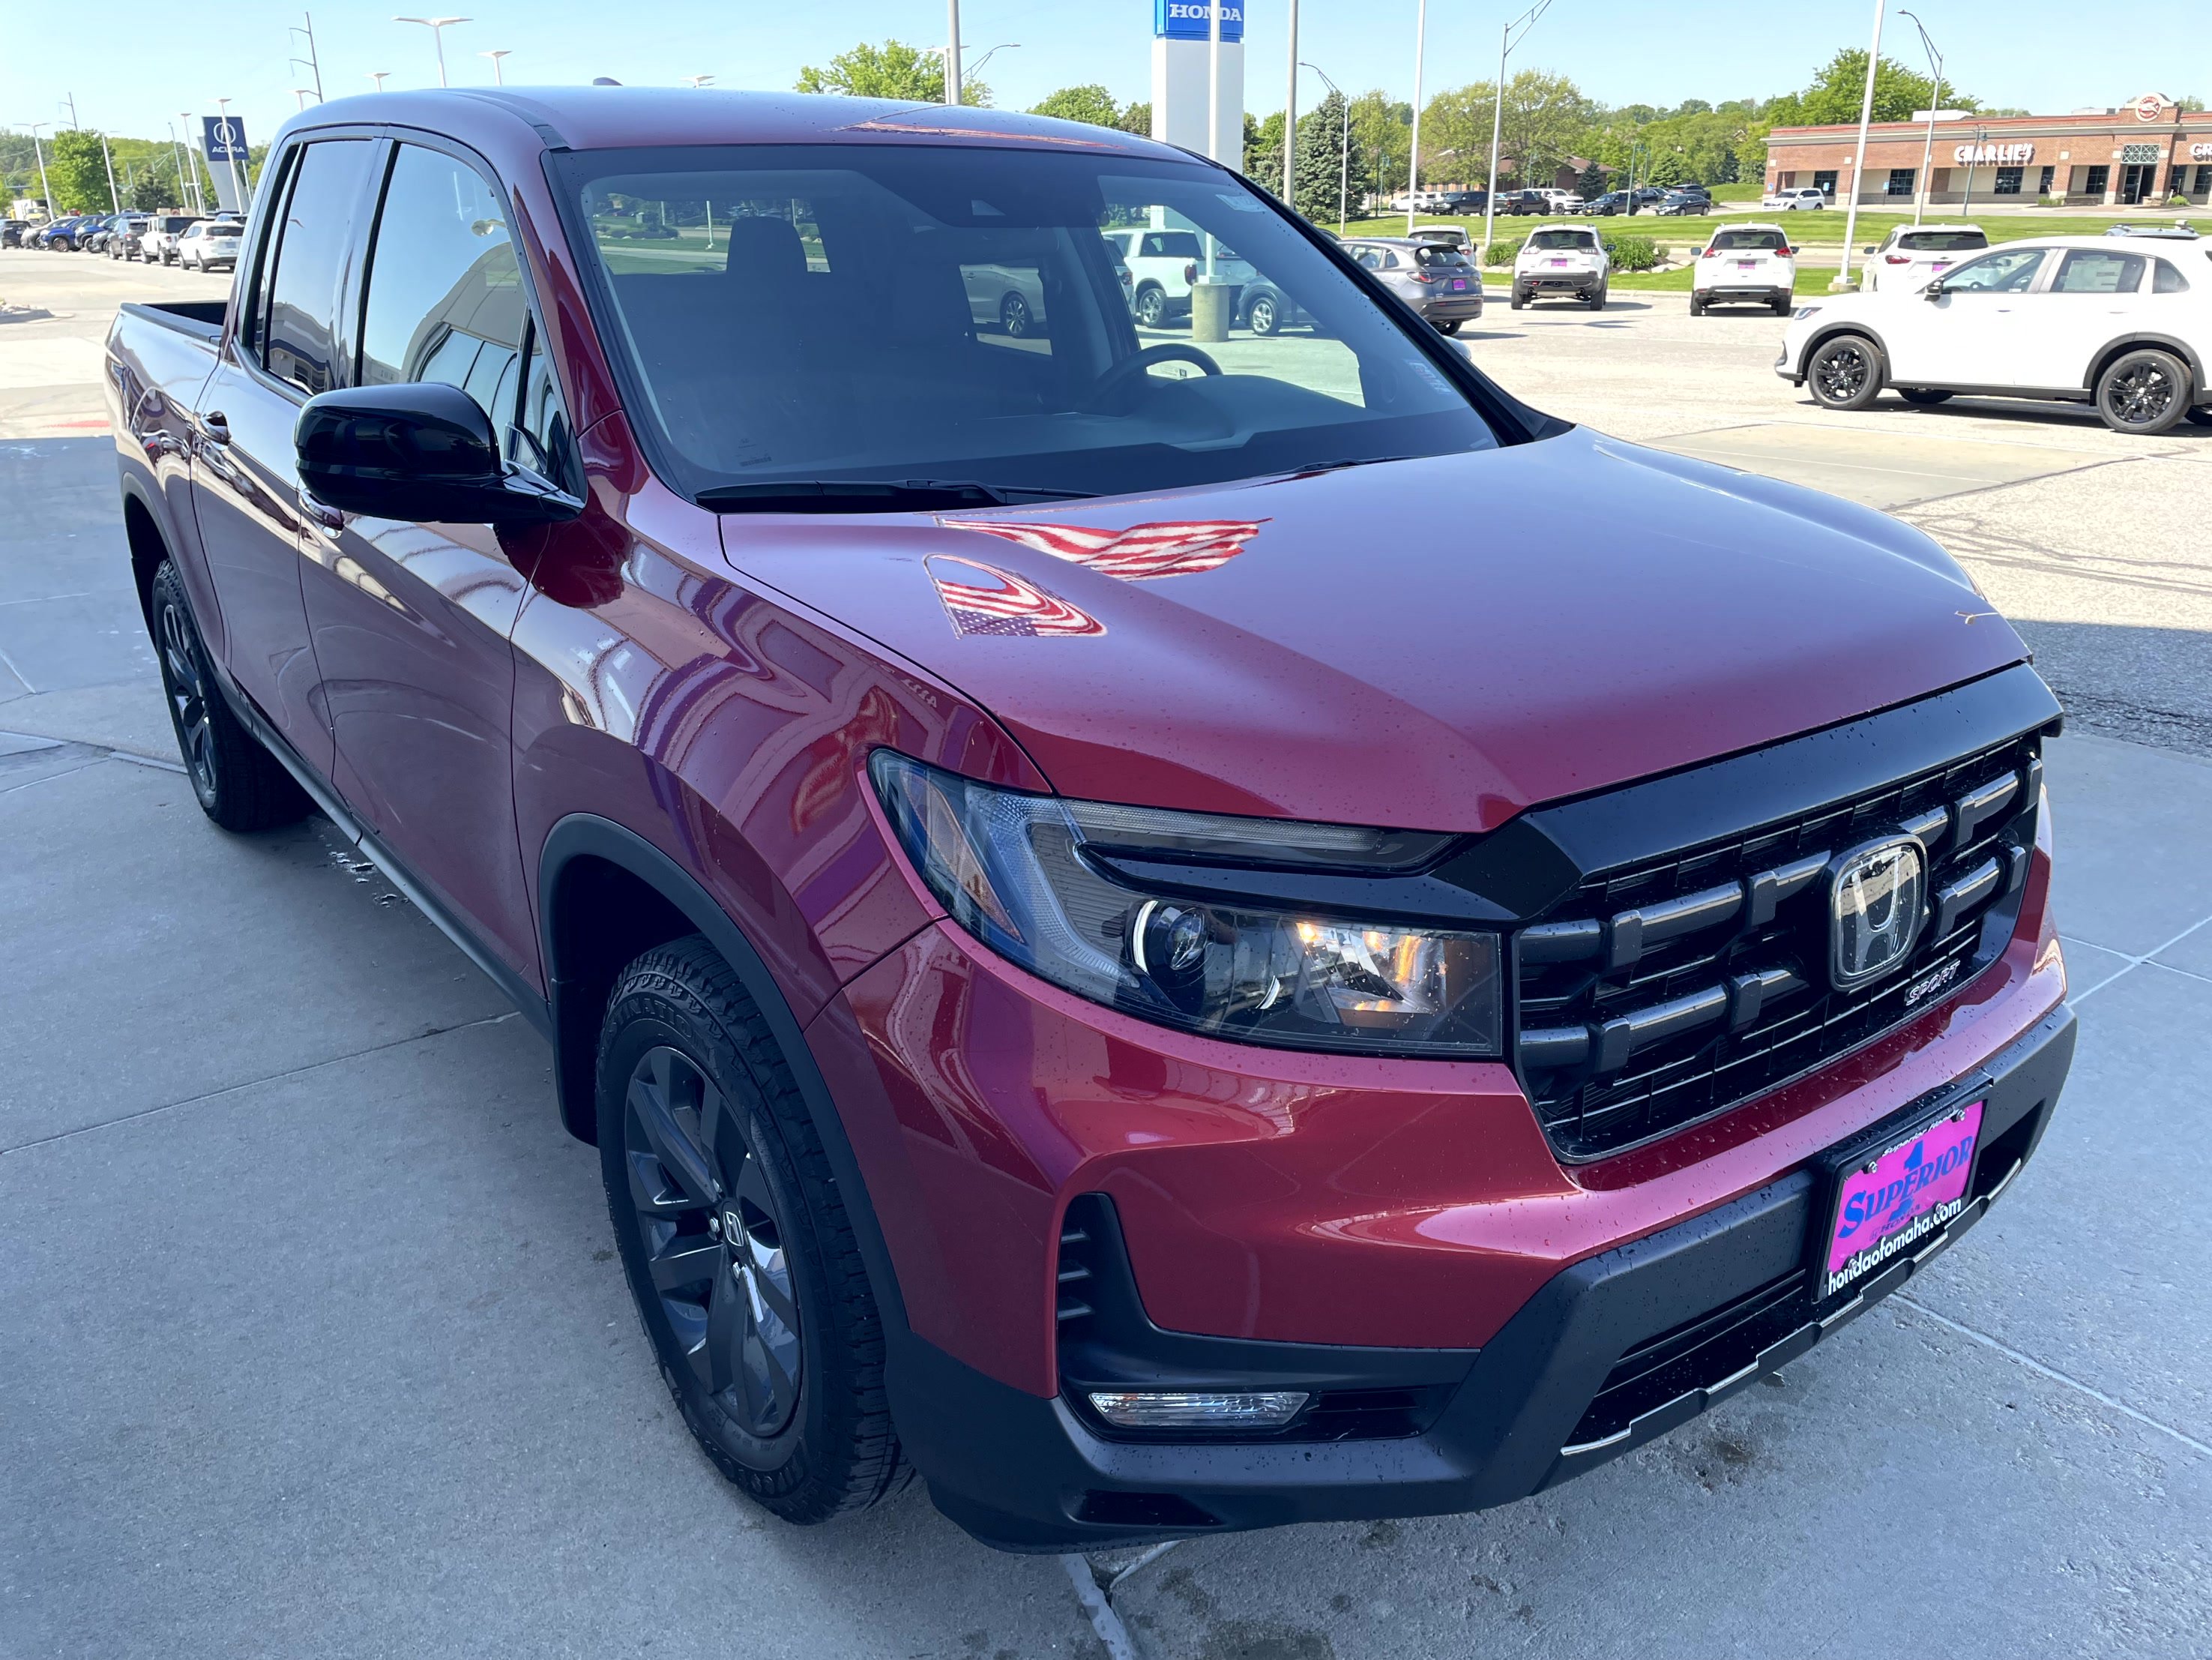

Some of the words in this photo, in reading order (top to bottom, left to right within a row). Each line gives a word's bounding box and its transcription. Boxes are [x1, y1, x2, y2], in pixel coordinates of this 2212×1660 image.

[1905, 960, 1961, 1006] SPORT
[1881, 1128, 1928, 1158] Superior
[1837, 1135, 1974, 1239] SUPERIOR
[1827, 1198, 1962, 1296] hondaofomaha.com
